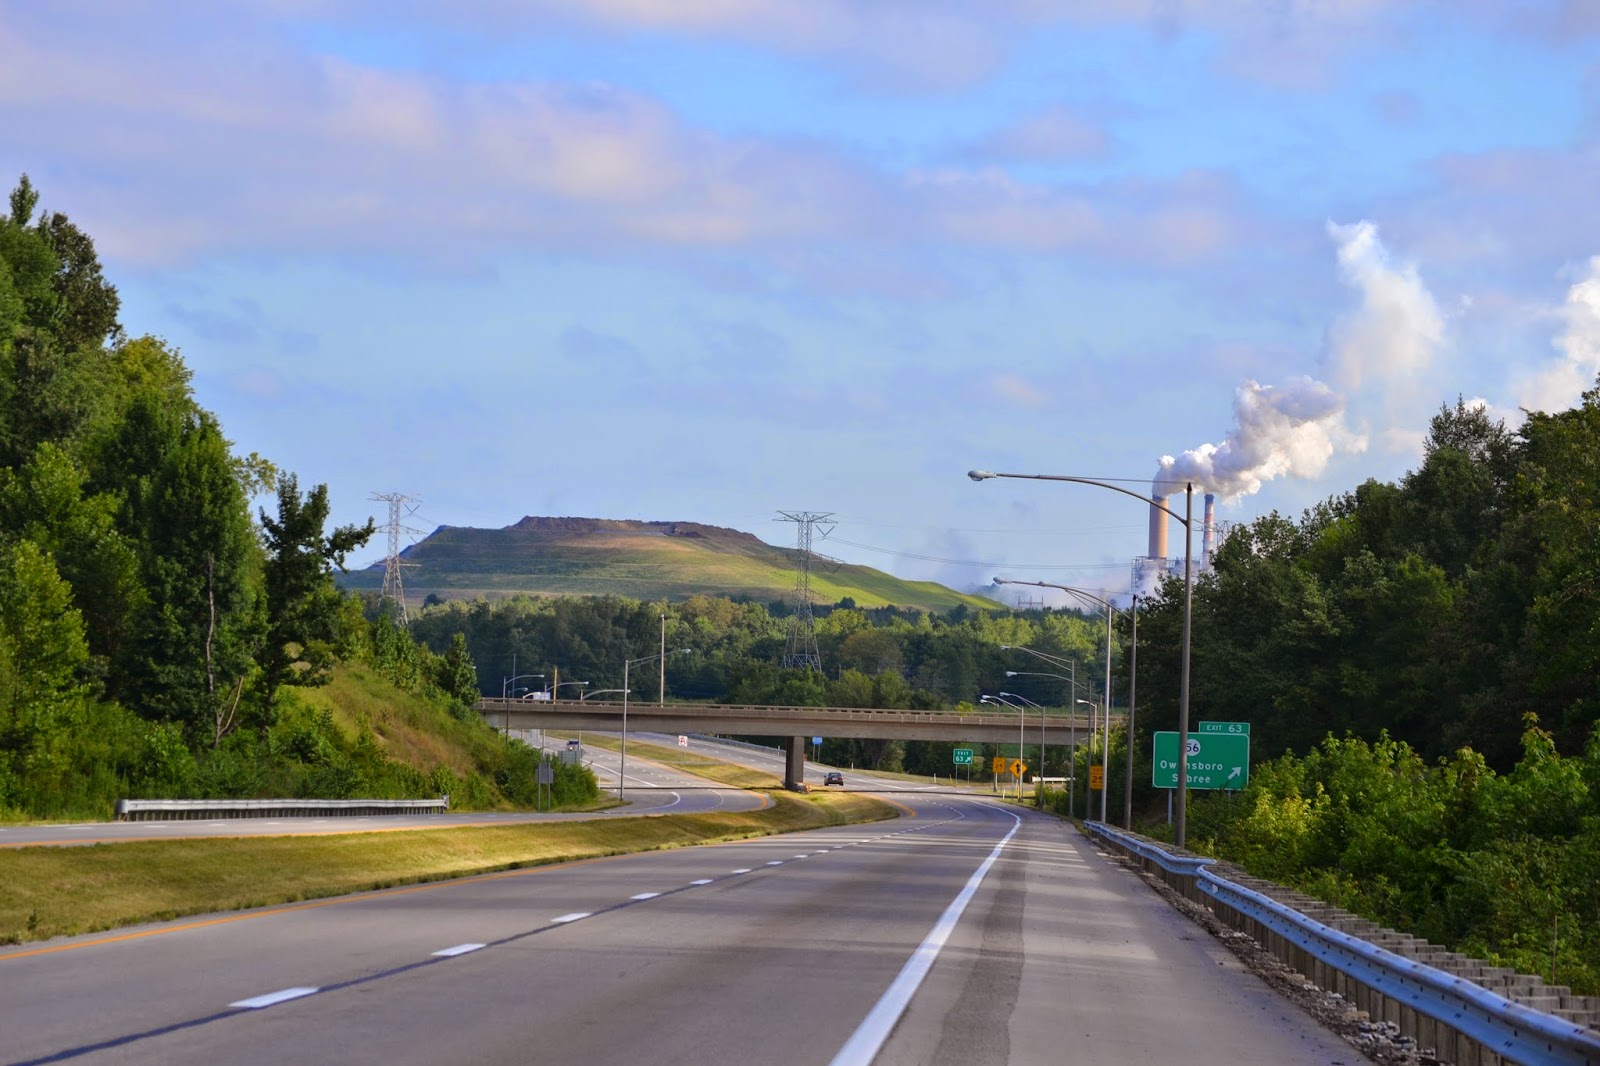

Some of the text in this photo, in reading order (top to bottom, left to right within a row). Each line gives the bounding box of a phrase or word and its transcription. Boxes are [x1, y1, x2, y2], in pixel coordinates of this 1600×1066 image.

[1228, 724, 1242, 733] 63
[1160, 760, 1223, 771] Ownsboro
[1172, 774, 1211, 784] Sbree
